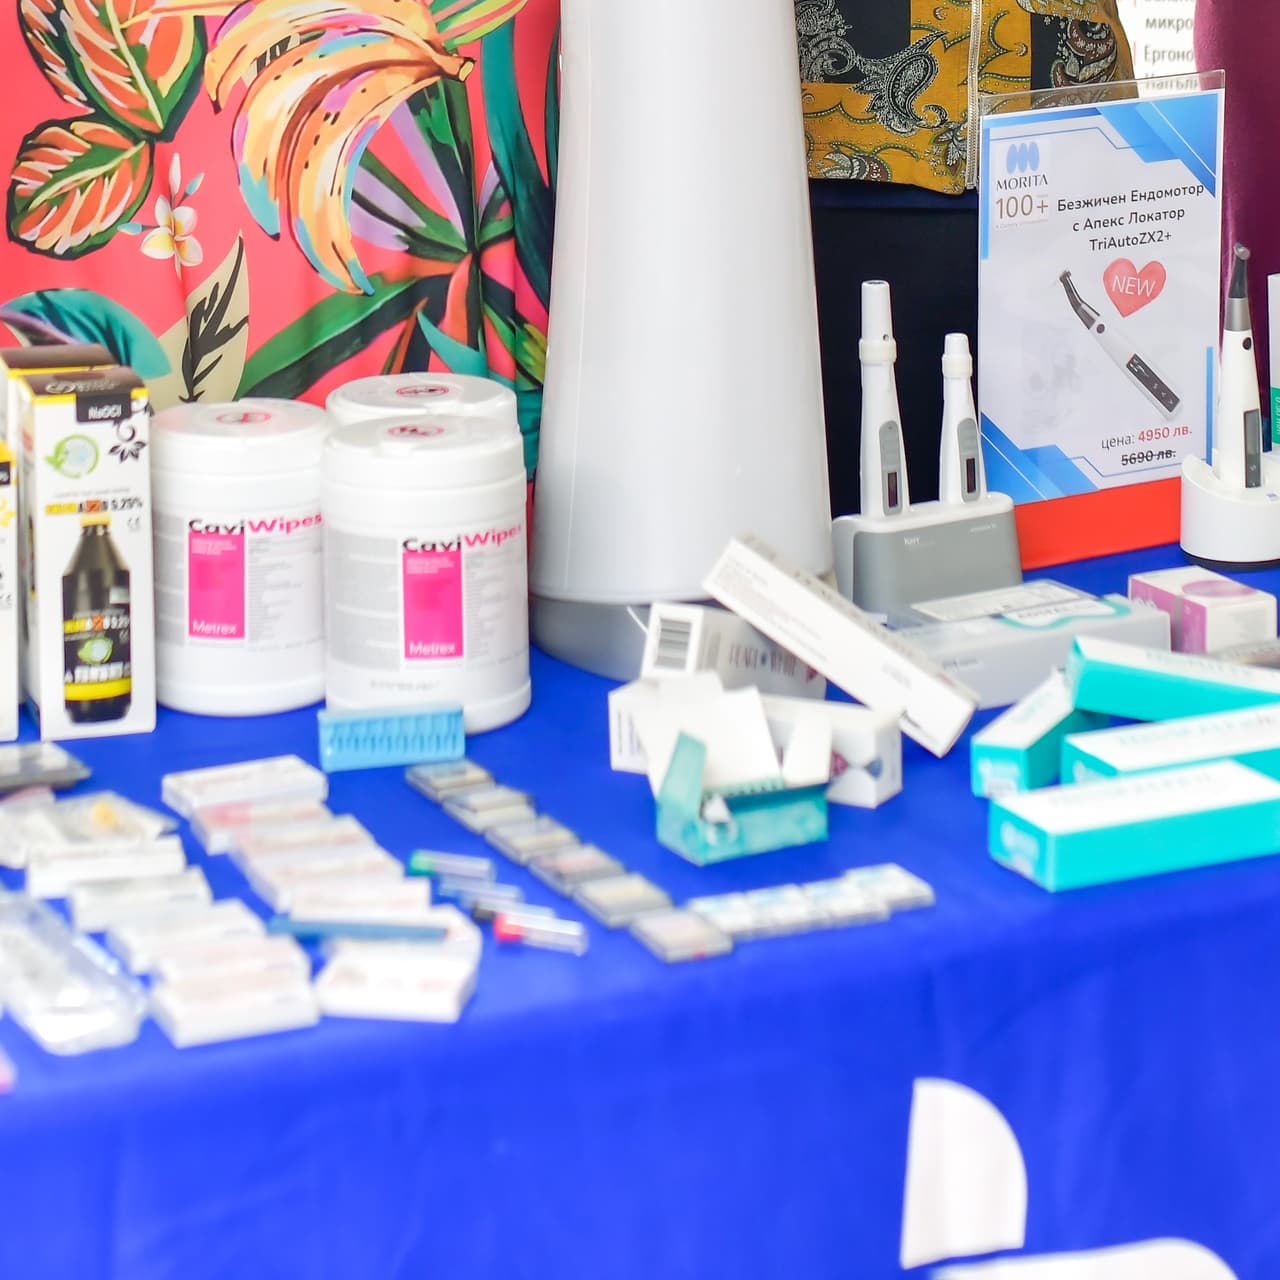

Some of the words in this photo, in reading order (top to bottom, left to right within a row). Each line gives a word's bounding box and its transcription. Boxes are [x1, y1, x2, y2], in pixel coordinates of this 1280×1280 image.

[996, 174, 1049, 192] MORITA
[995, 194, 1049, 220] 100+
[1056, 194, 1127, 212] Безжичен
[1130, 183, 1205, 203] Ендомотор
[1072, 222, 1080, 232] с
[1083, 215, 1125, 231] Апекс
[1127, 208, 1186, 226] Локатор
[1089, 231, 1173, 252] TriAutoZX2+
[1111, 275, 1157, 298] NEW
[1100, 432, 1136, 451] цена:
[1137, 426, 1171, 443] 4950
[1172, 424, 1193, 438] лв.
[1120, 451, 1155, 467] 5690
[188, 512, 322, 537] CaviWipes
[192, 620, 237, 636] Metrex
[409, 641, 456, 657] Metrex
